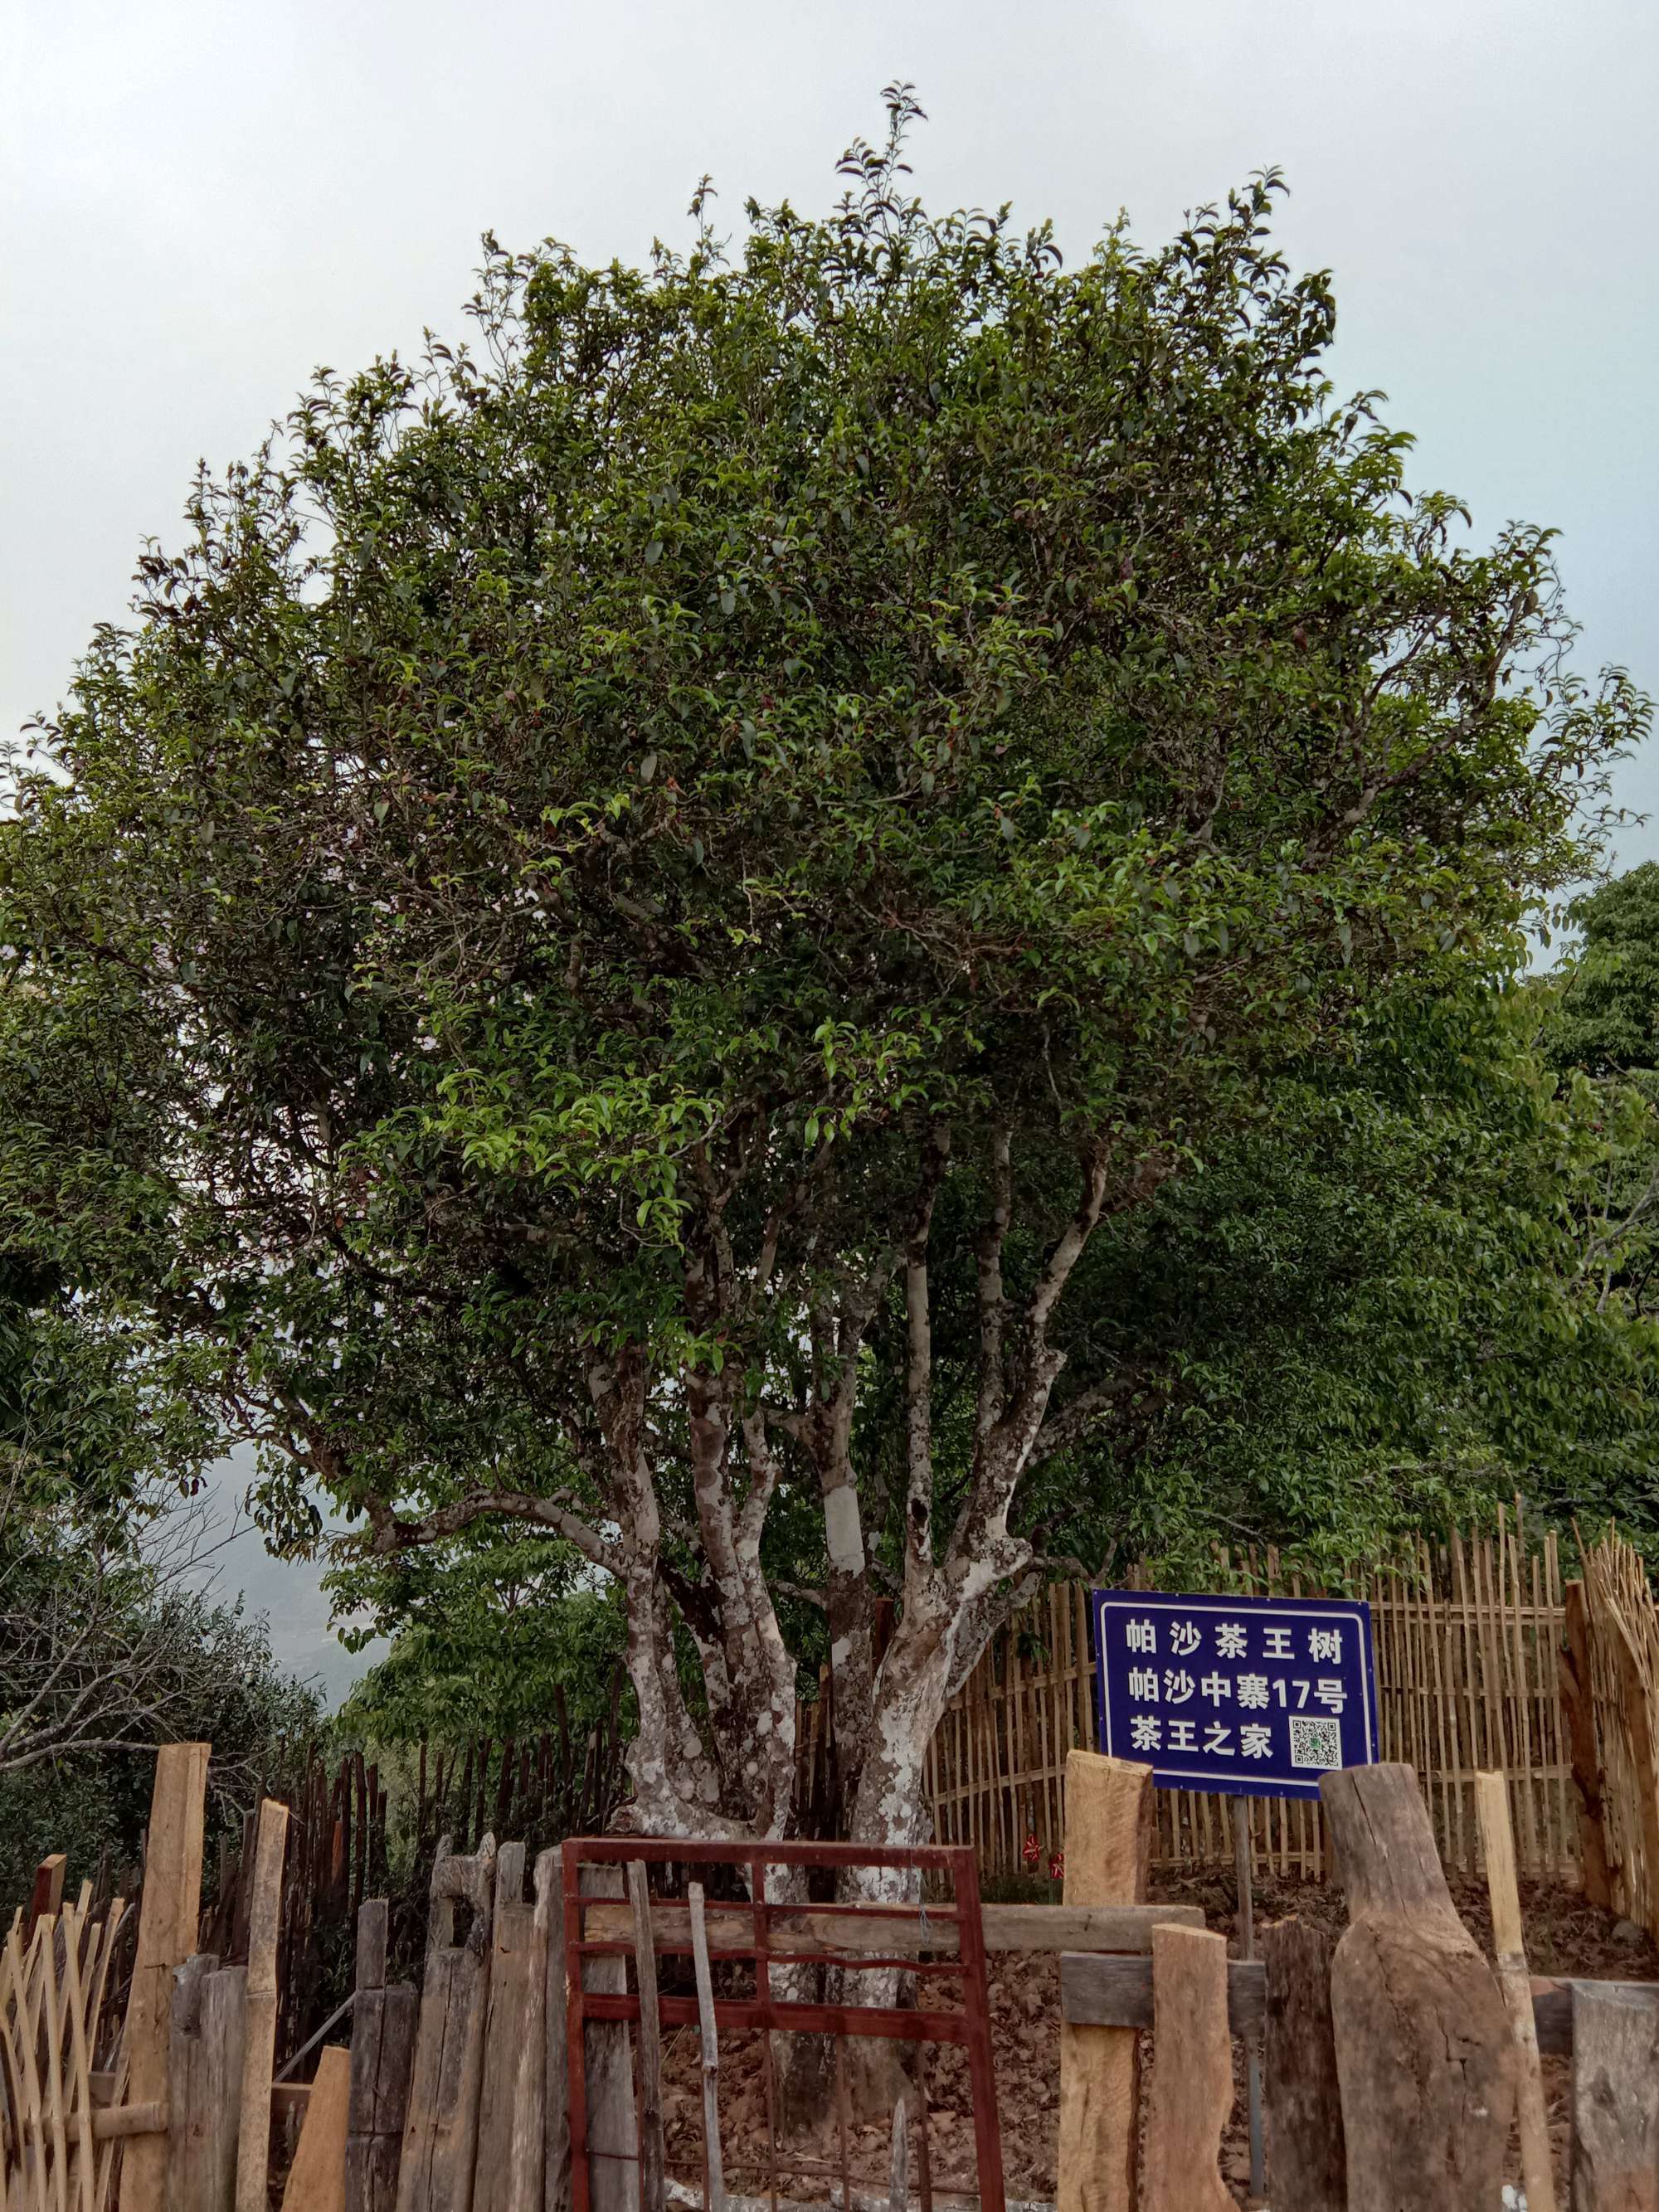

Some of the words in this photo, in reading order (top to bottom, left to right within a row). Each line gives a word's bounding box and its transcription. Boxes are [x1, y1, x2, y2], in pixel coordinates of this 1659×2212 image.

[1126, 1618, 1343, 1665] 帕沙茶王树
[1128, 1666, 1348, 1714] 帕沙中寨17号
[1130, 1714, 1273, 1759] 茶王之家
